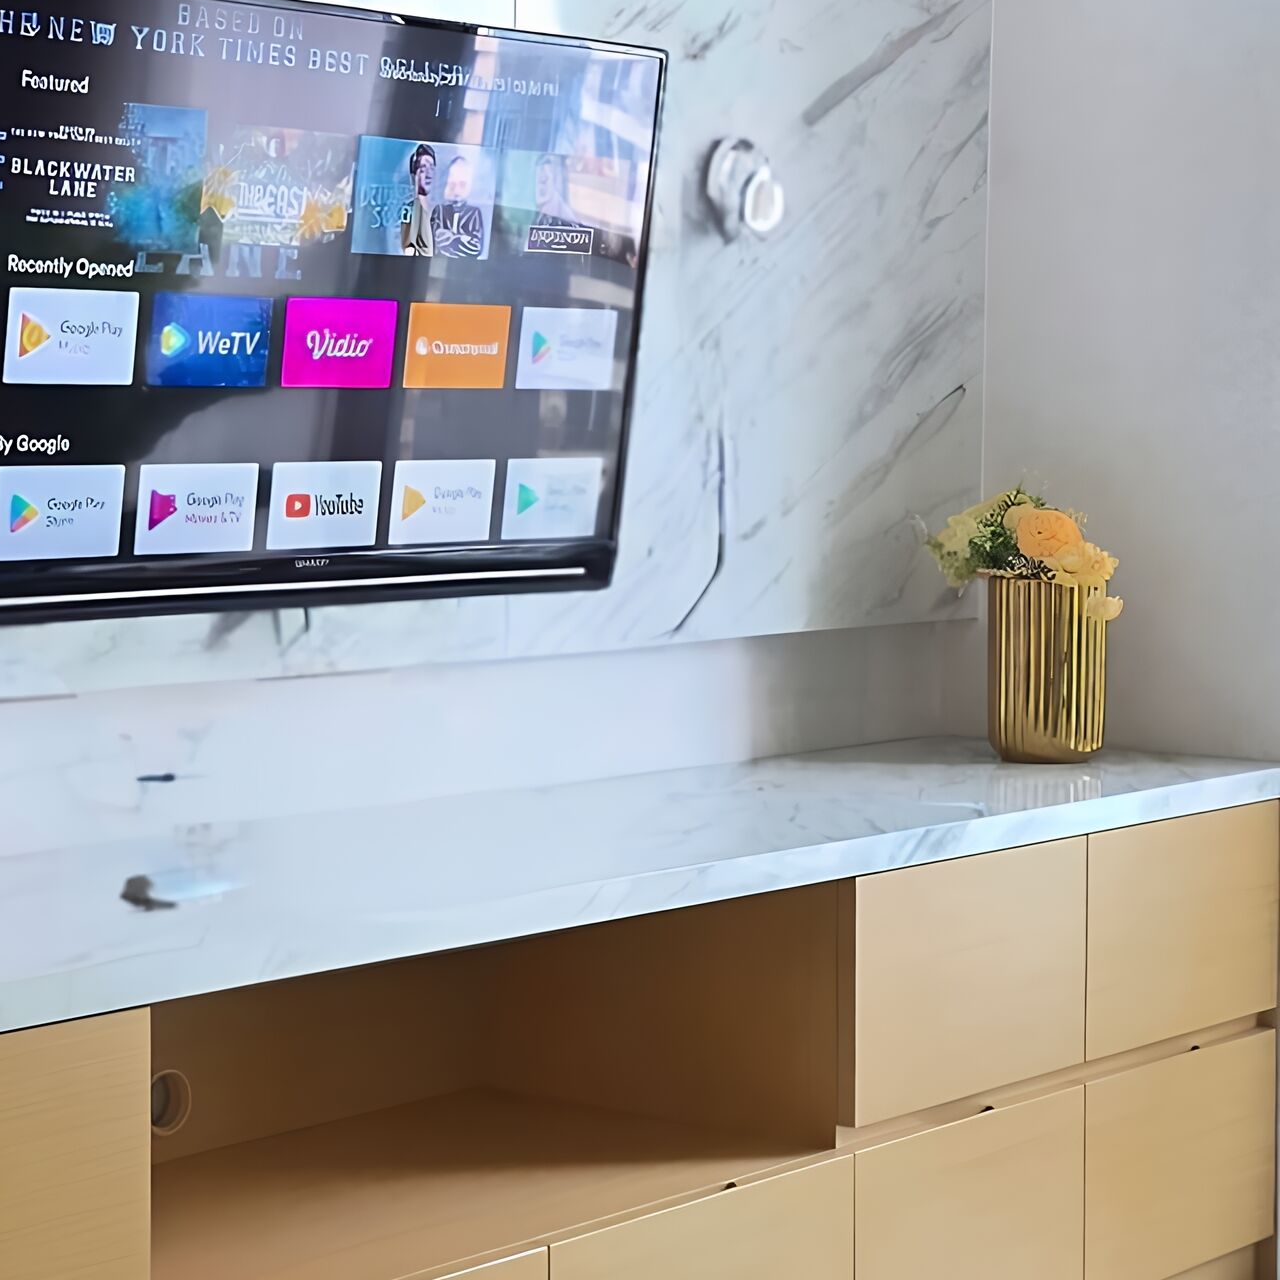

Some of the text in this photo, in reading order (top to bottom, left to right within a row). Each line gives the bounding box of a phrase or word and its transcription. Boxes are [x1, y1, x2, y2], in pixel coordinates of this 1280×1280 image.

[178, 3, 303, 41] BASED ON
[131, 26, 205, 57] YORK
[219, 37, 296, 67] TIMES
[308, 48, 369, 76] BEST
[11, 157, 136, 183] BLACKWATER
[49, 179, 98, 198] LANE
[8, 254, 135, 280] Recently Opened
[197, 330, 261, 355] WeTV
[306, 328, 373, 361] Vidio
[16, 434, 70, 456] Google
[314, 492, 364, 517] YouTube
